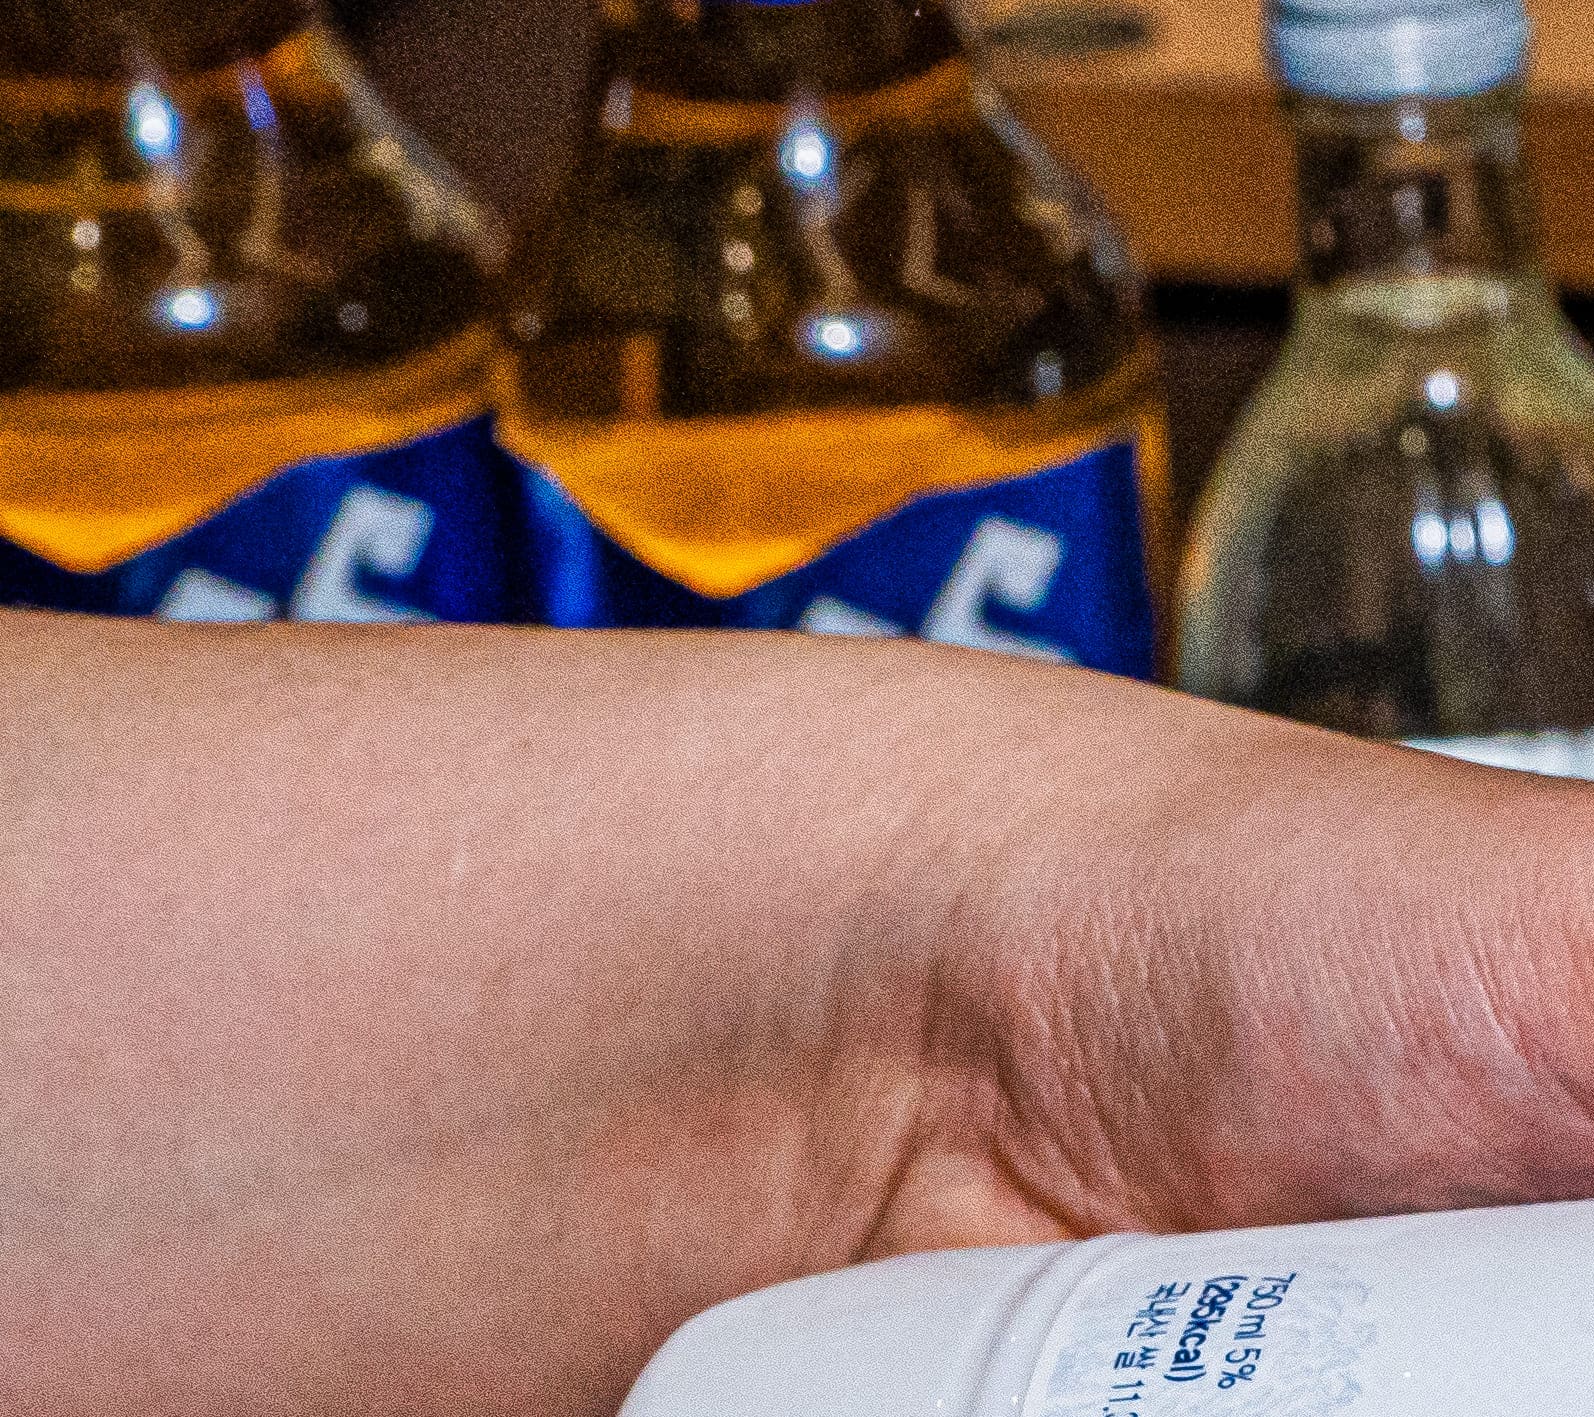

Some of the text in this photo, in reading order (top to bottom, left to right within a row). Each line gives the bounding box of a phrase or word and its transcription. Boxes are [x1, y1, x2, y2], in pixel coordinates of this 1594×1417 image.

[1127, 1281, 1192, 1339] 국내산
[1113, 1345, 1160, 1370] 쌀
[1217, 1348, 1262, 1390] 5%
